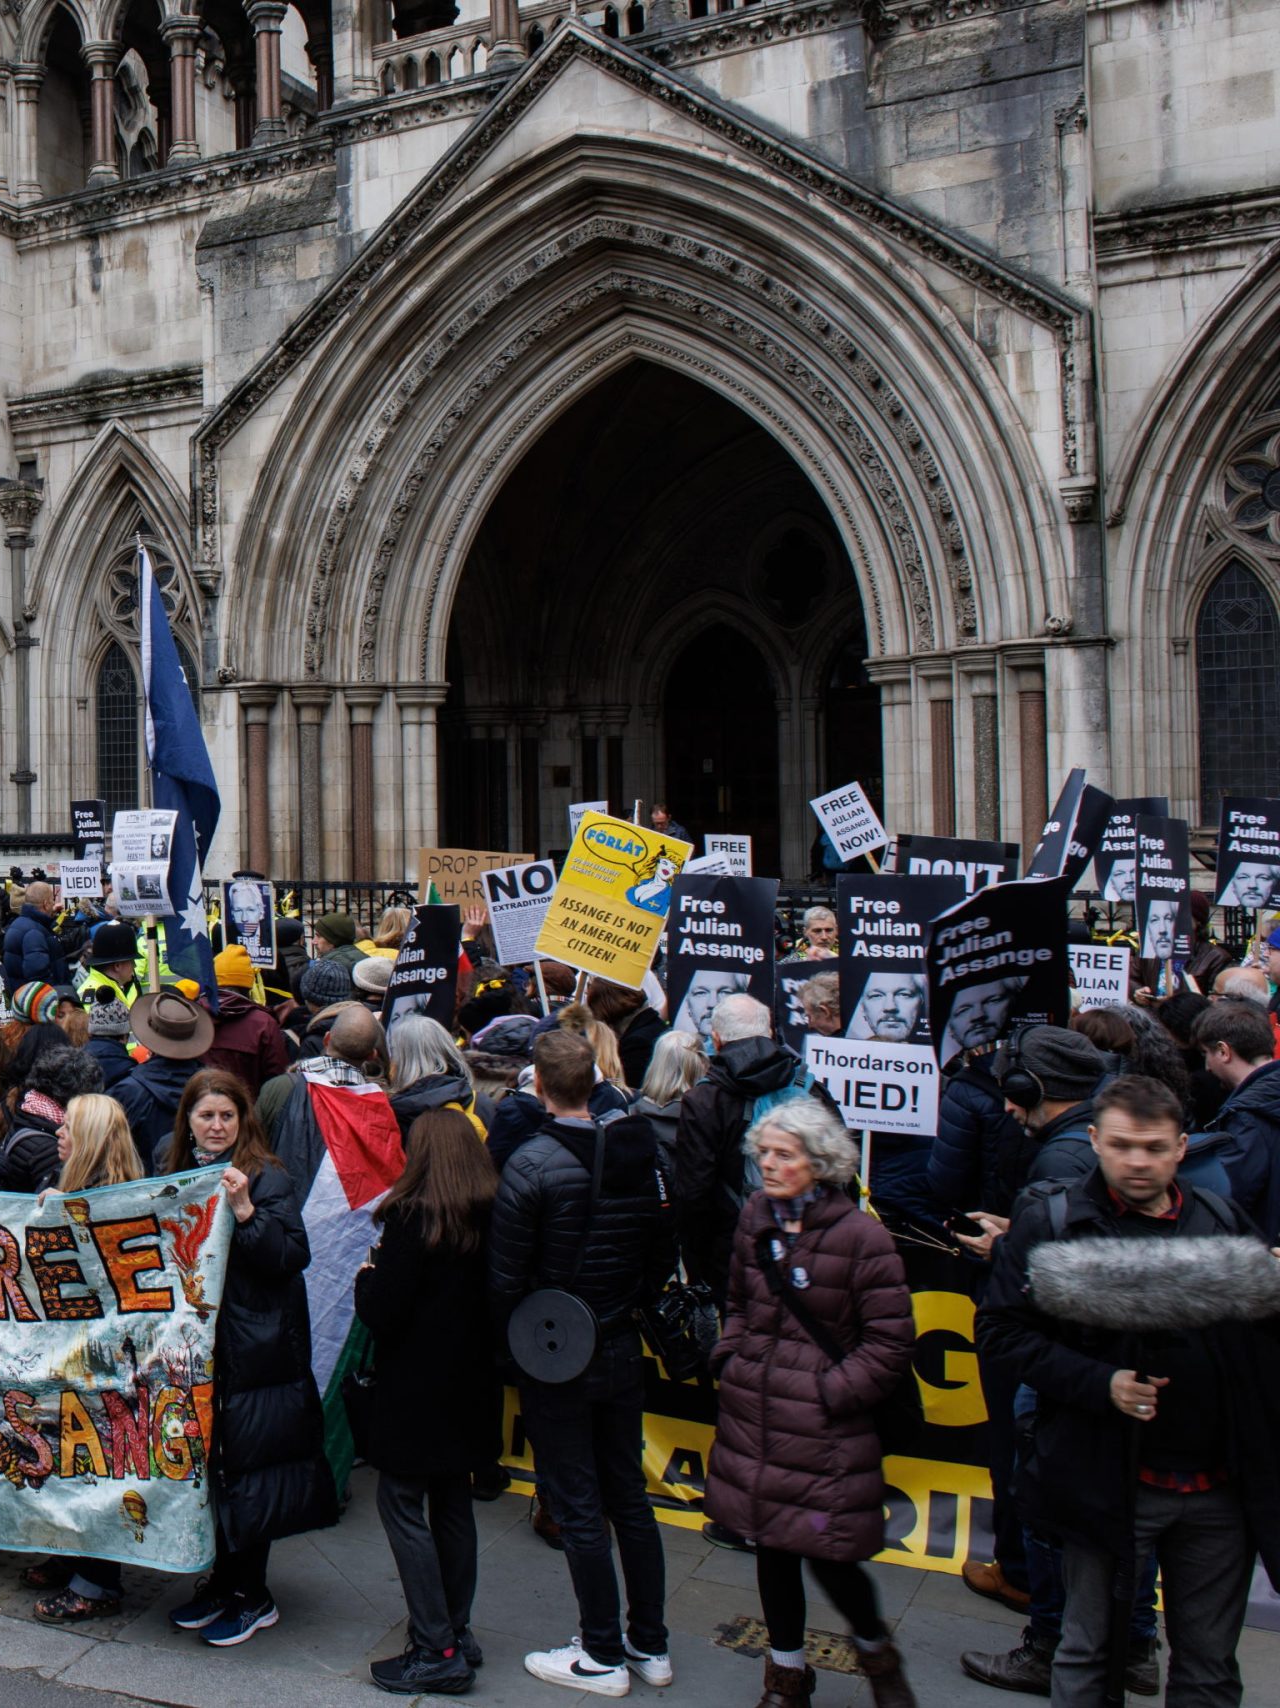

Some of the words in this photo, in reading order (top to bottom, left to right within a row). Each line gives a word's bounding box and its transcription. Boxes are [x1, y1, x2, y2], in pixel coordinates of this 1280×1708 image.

[821, 791, 860, 815] FREE
[74, 810, 94, 819] Free
[832, 807, 865, 827] JULIAN
[1229, 811, 1267, 825] Free
[836, 818, 871, 837] ASSANGE
[1102, 825, 1136, 839] Julia
[1228, 825, 1279, 840] Julian
[586, 827, 645, 858] FÖRLÅT
[711, 841, 747, 854] FREE
[840, 827, 881, 852] NOW!
[1101, 840, 1136, 852] Assa
[1139, 834, 1165, 850] Free
[62, 865, 99, 873] Thordarson
[428, 855, 478, 874] DROP
[730, 858, 746, 866] IAN
[1140, 853, 1172, 870] Julian
[66, 876, 97, 889] LIED!
[486, 864, 554, 902] NO
[1140, 872, 1186, 893] Assange
[680, 896, 725, 914] Free
[850, 896, 901, 915] Free
[559, 897, 614, 924] ASSANGE
[613, 915, 627, 929] IS
[628, 920, 653, 938] NOT
[679, 917, 742, 937] Julian
[560, 916, 578, 931] AN
[578, 922, 641, 953] AMERICAN
[851, 918, 921, 937] Julian
[936, 916, 991, 946] Free
[237, 937, 261, 947] FREE
[567, 938, 617, 964] CITIZEN!
[679, 938, 765, 964] Assange
[851, 940, 927, 959] Assan
[936, 930, 1013, 965] Julian
[397, 948, 425, 965] ulian
[390, 967, 447, 987] Assange
[938, 948, 1053, 987] Assange
[1075, 977, 1119, 991] ULIAN
[812, 1048, 933, 1075] Thordarson
